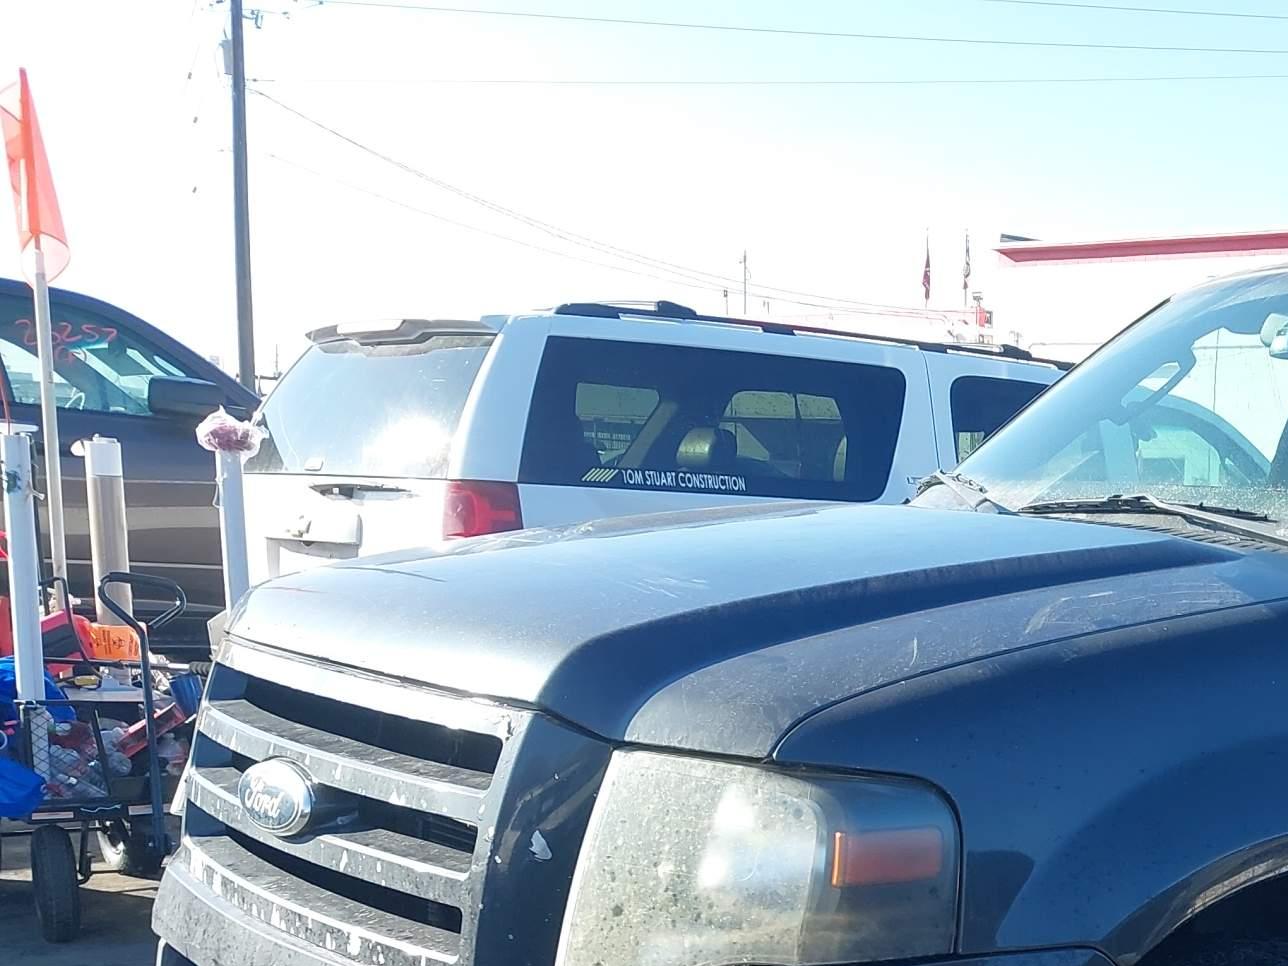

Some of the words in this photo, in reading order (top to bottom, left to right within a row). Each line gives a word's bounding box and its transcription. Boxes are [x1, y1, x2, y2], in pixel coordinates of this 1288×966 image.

[645, 470, 676, 488] STUART
[678, 472, 746, 491] CONSTRUCTION
[244, 776, 286, 819] Ford
